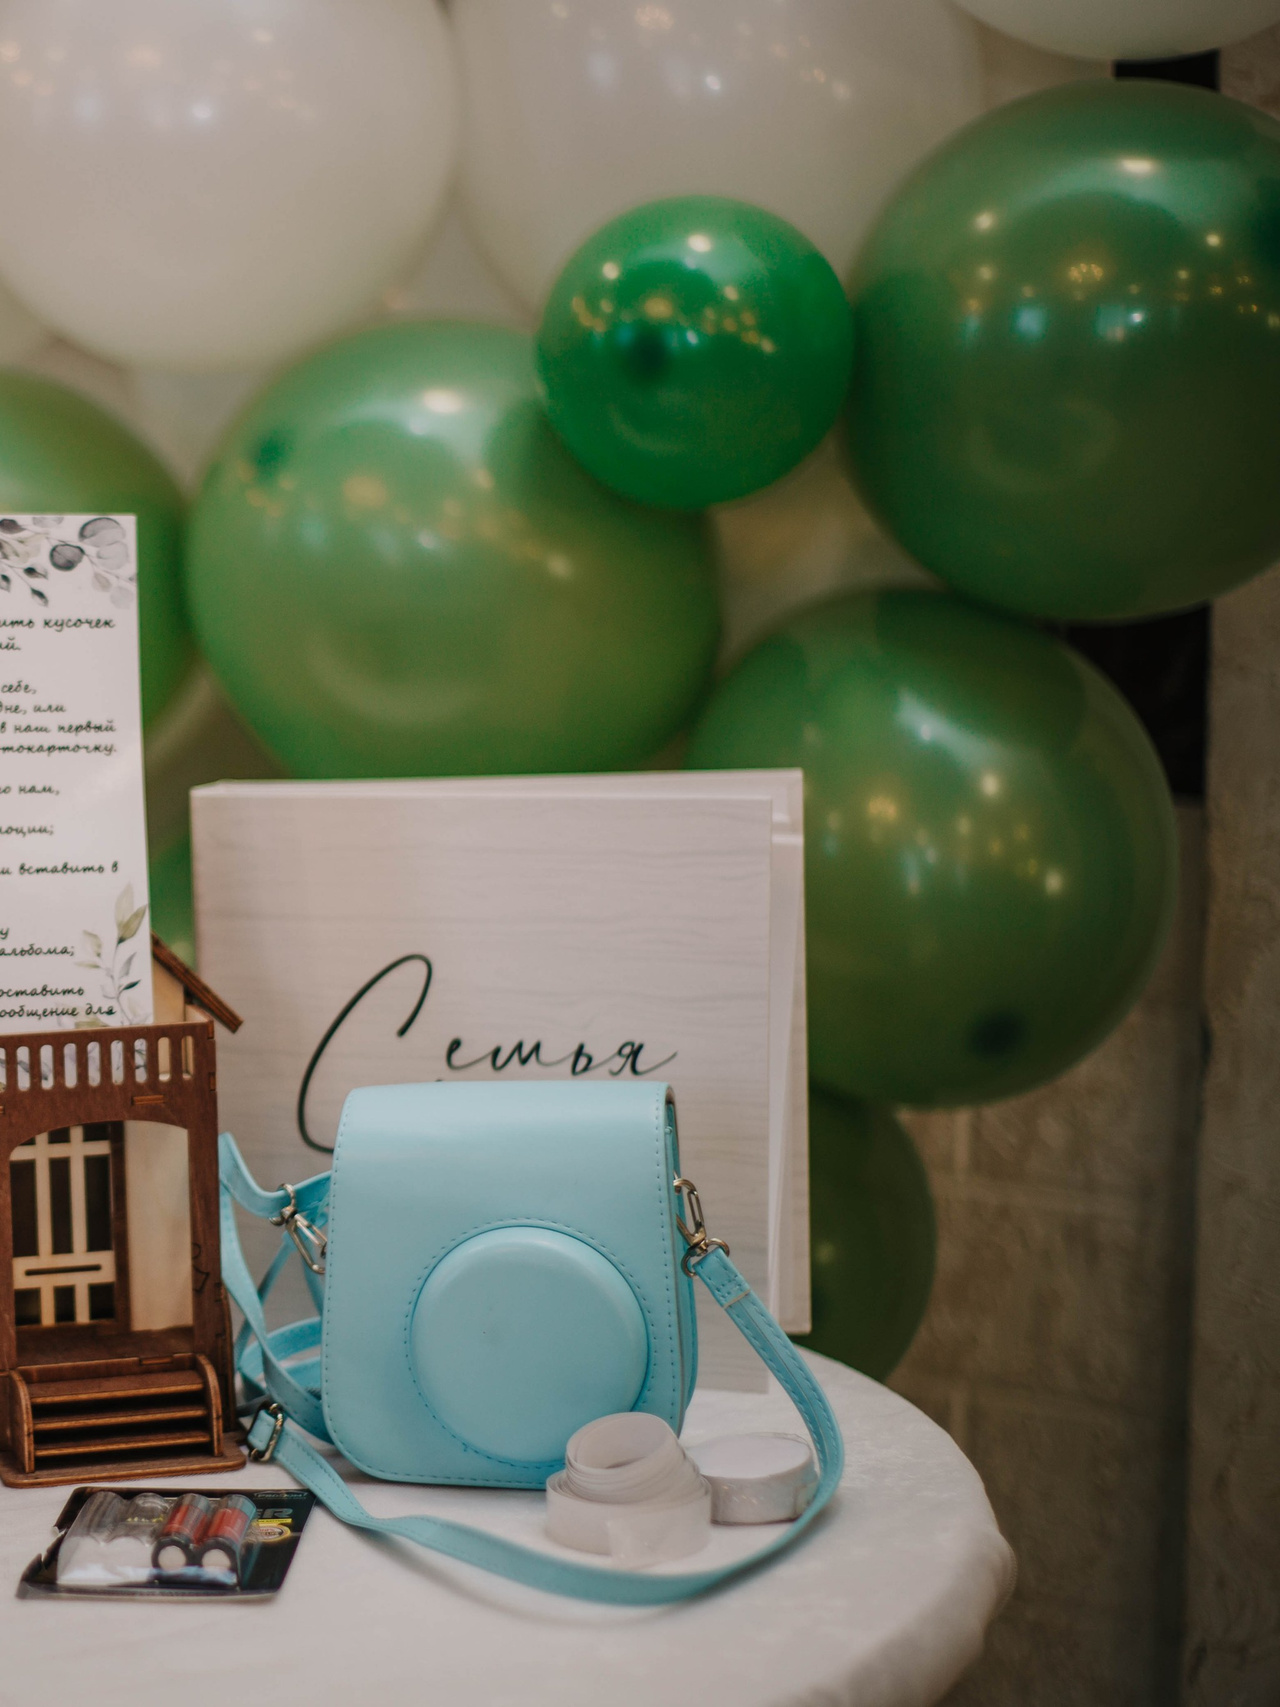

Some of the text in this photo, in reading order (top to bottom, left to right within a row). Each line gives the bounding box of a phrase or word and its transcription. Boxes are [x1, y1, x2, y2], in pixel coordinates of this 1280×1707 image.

[43, 618, 115, 633] кусочек
[0, 679, 37, 695] себе,
[33, 704, 66, 713] или
[0, 721, 7, 734] в
[13, 724, 50, 734] наш
[57, 720, 116, 735] первый
[18, 785, 60, 795] нам,
[18, 861, 105, 876] вставить
[111, 860, 119, 874] в
[84, 1002, 118, 1018] для
[296, 953, 679, 1156] Семья
